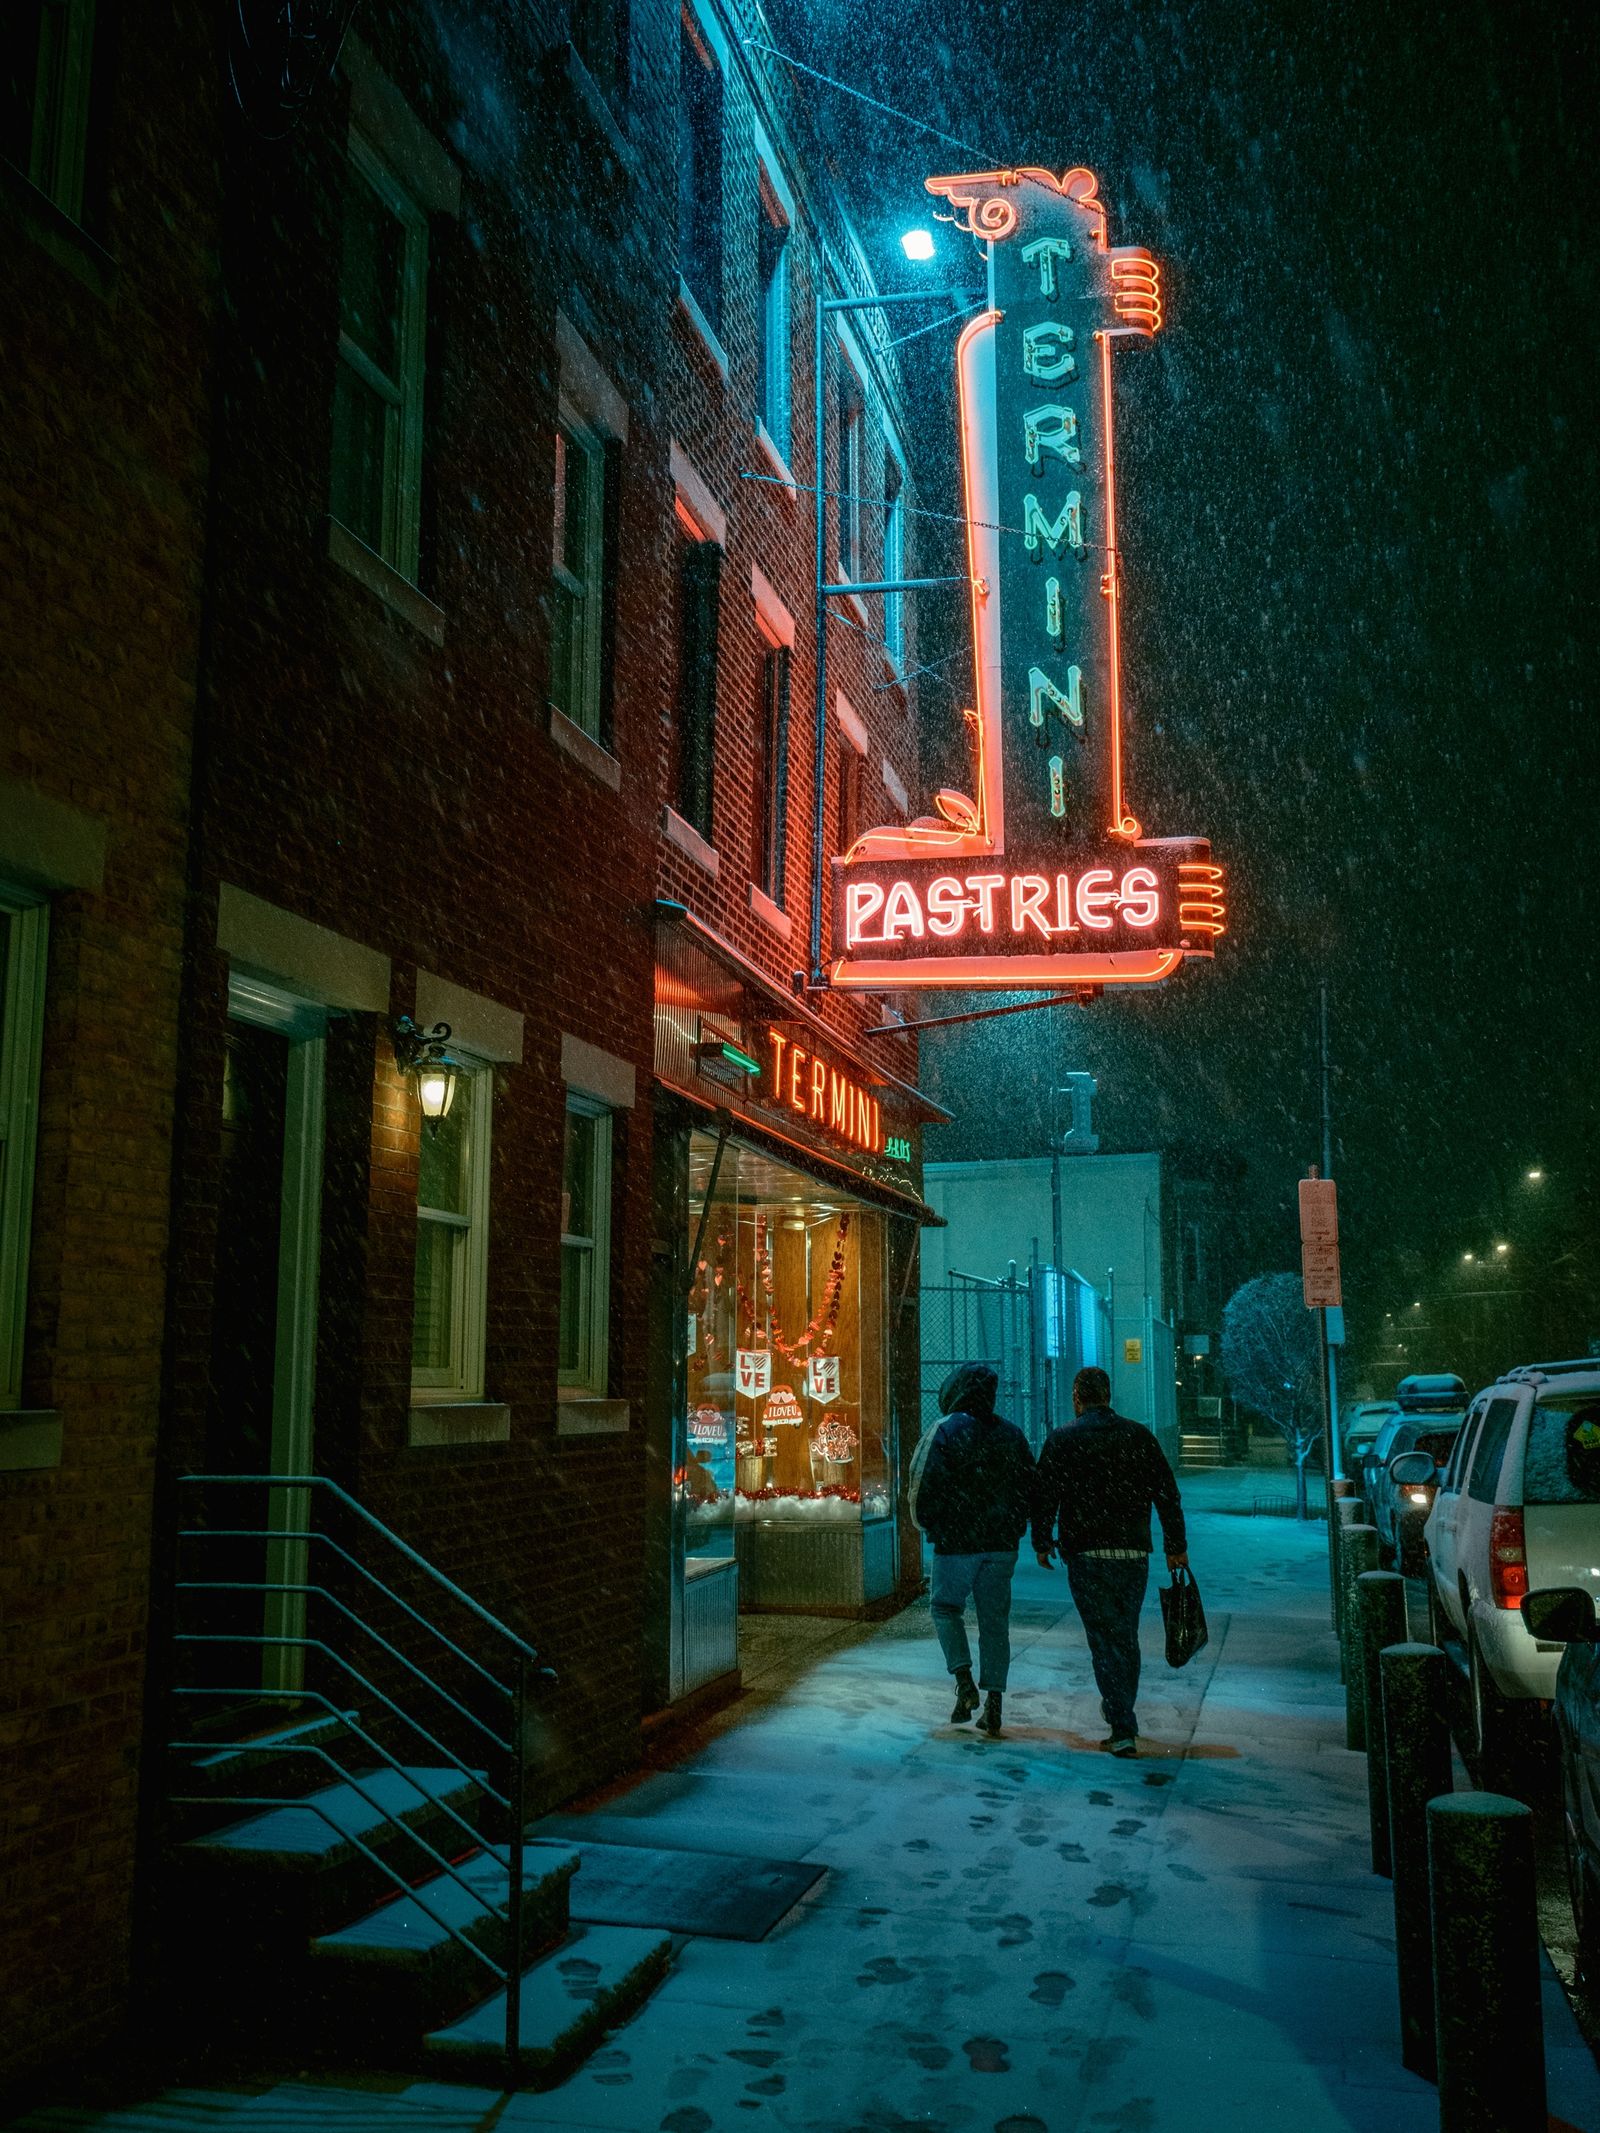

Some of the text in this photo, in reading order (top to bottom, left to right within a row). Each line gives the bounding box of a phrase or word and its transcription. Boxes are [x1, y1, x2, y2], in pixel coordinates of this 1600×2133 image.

[1022, 237, 1085, 819] TERMINI
[845, 867, 1159, 947] PASTRIES
[769, 1025, 881, 1153] TERMINI
